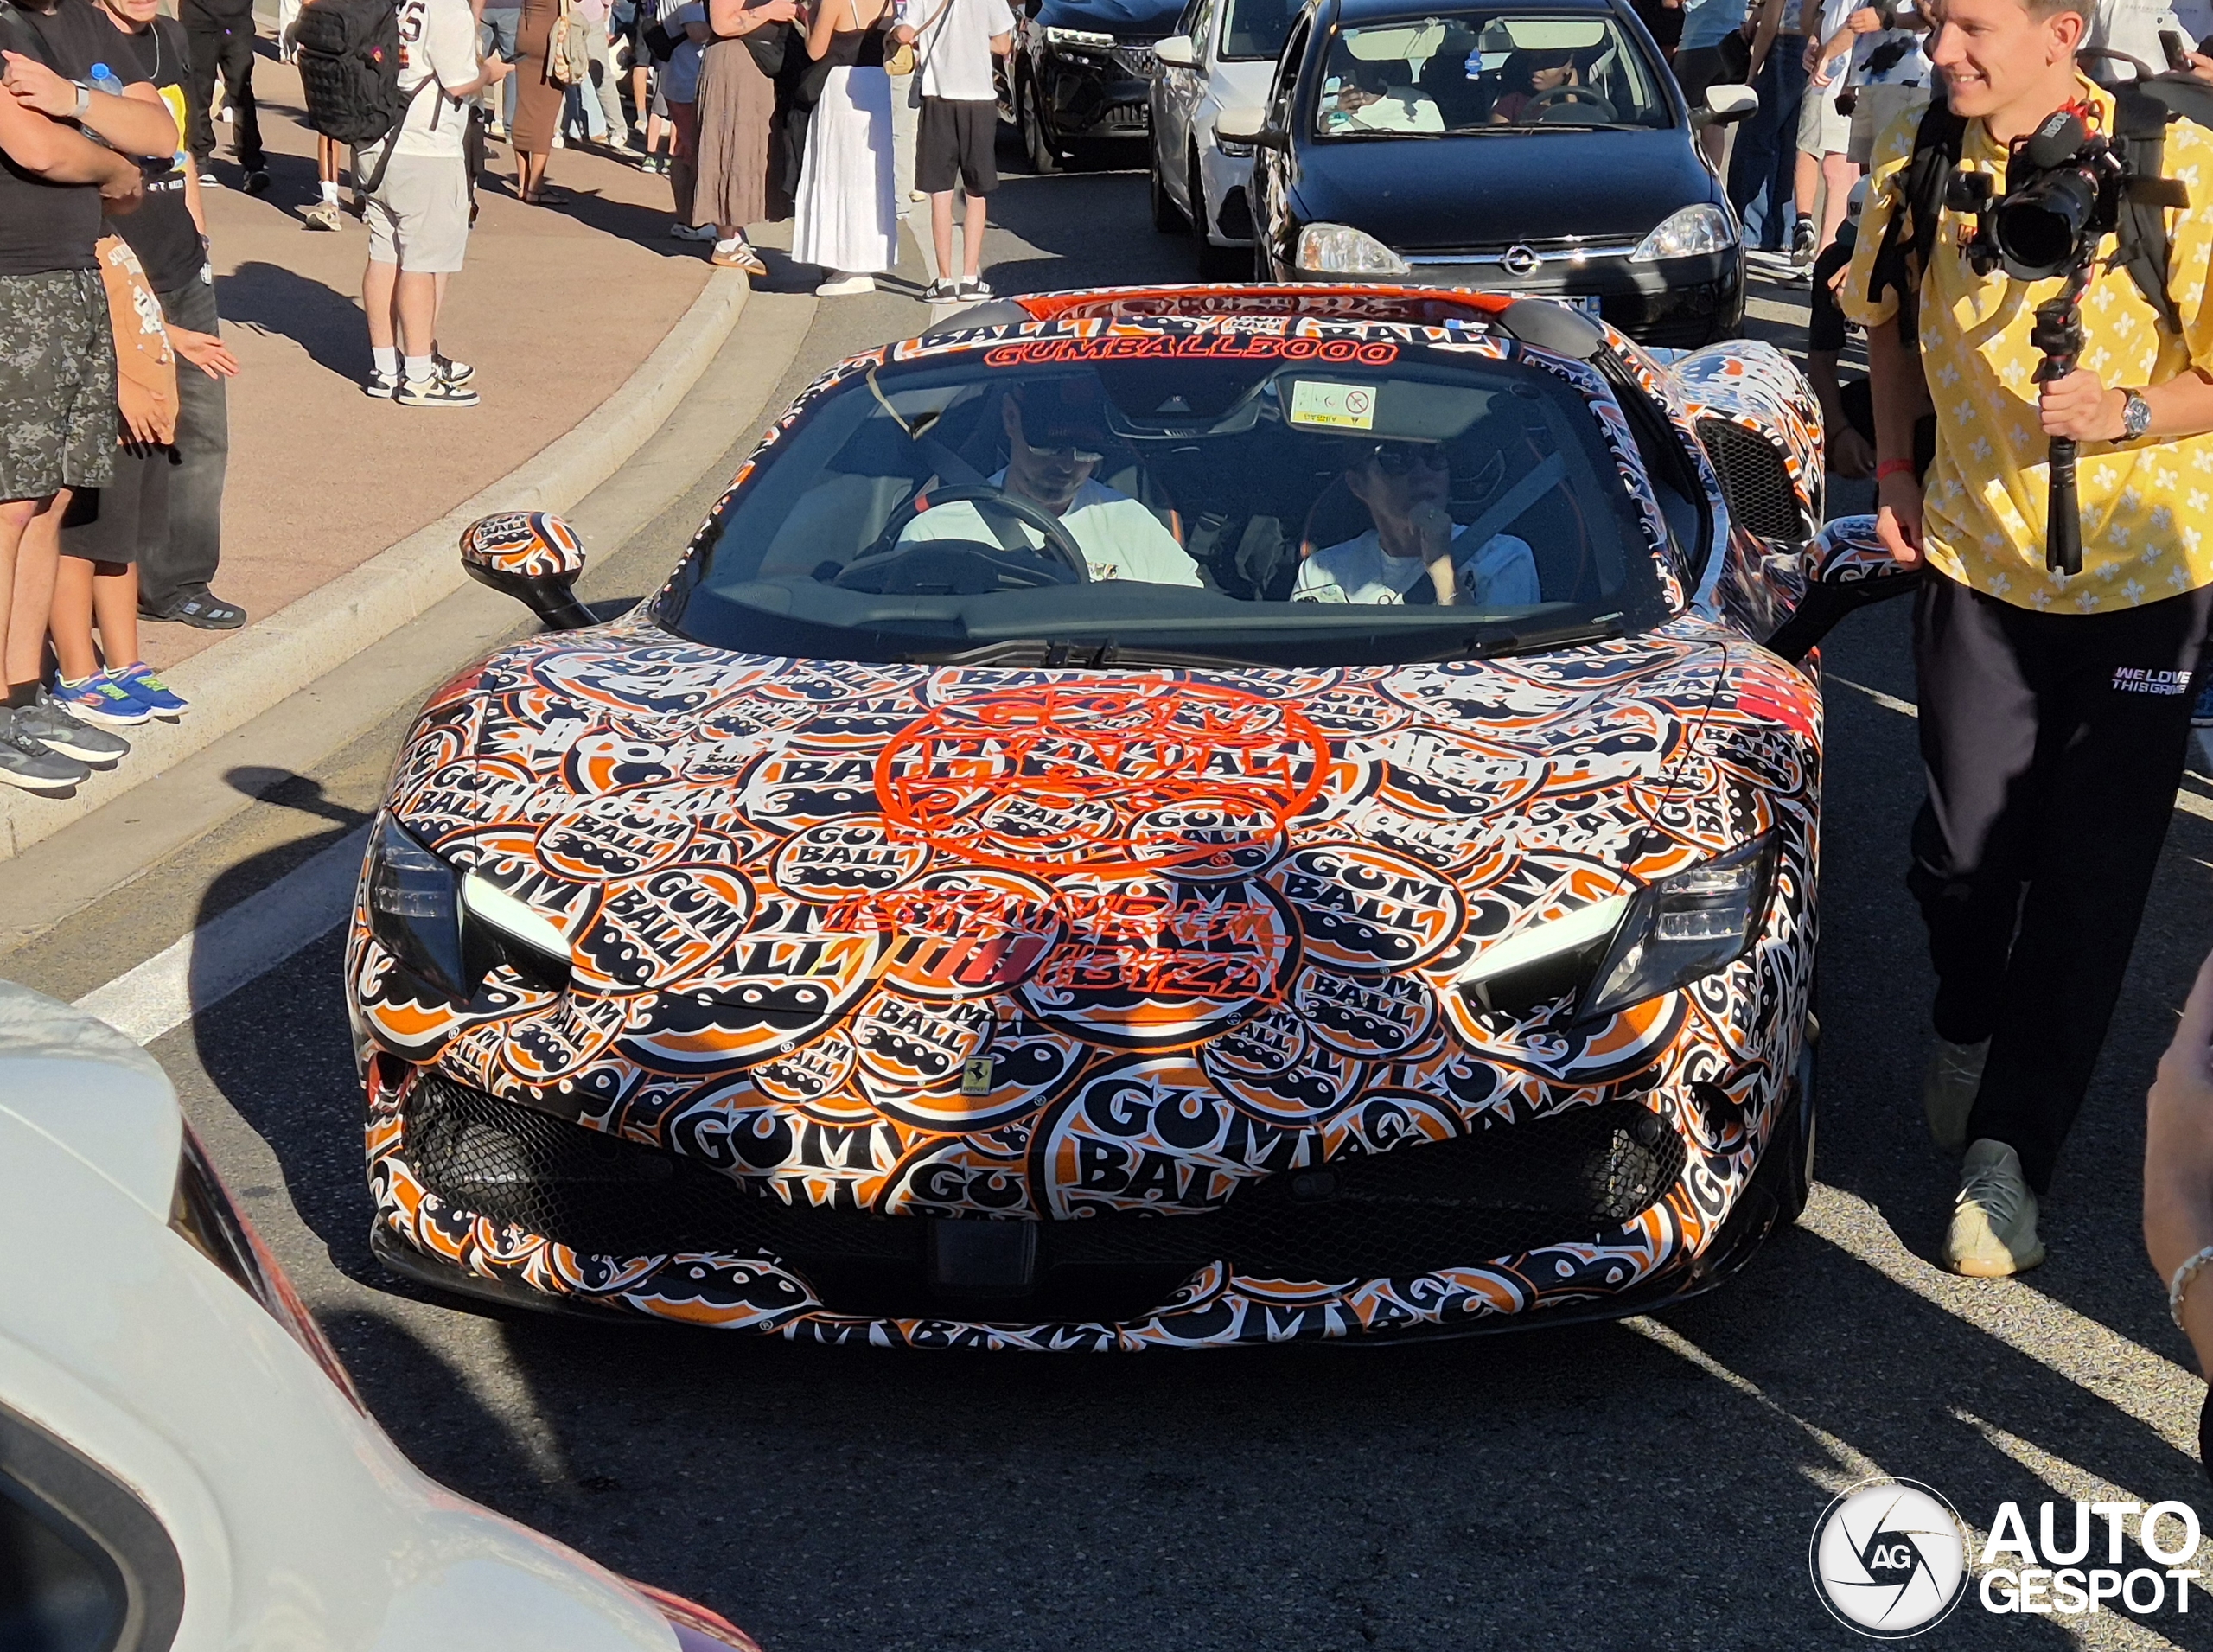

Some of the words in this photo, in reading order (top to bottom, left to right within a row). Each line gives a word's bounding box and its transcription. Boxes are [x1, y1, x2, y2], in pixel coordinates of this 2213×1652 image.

[984, 335, 1399, 367] GUMBALL3000
[539, 832, 641, 874] 3000
[575, 813, 660, 859] BALL
[795, 845, 907, 867] BALL
[779, 865, 899, 889] 3000
[1295, 850, 1451, 909] GUM
[607, 886, 693, 966] BALL
[647, 871, 742, 942] GUM
[1285, 871, 1428, 941] BALL
[858, 1024, 951, 1077] 3000
[880, 1000, 963, 1055] BALL
